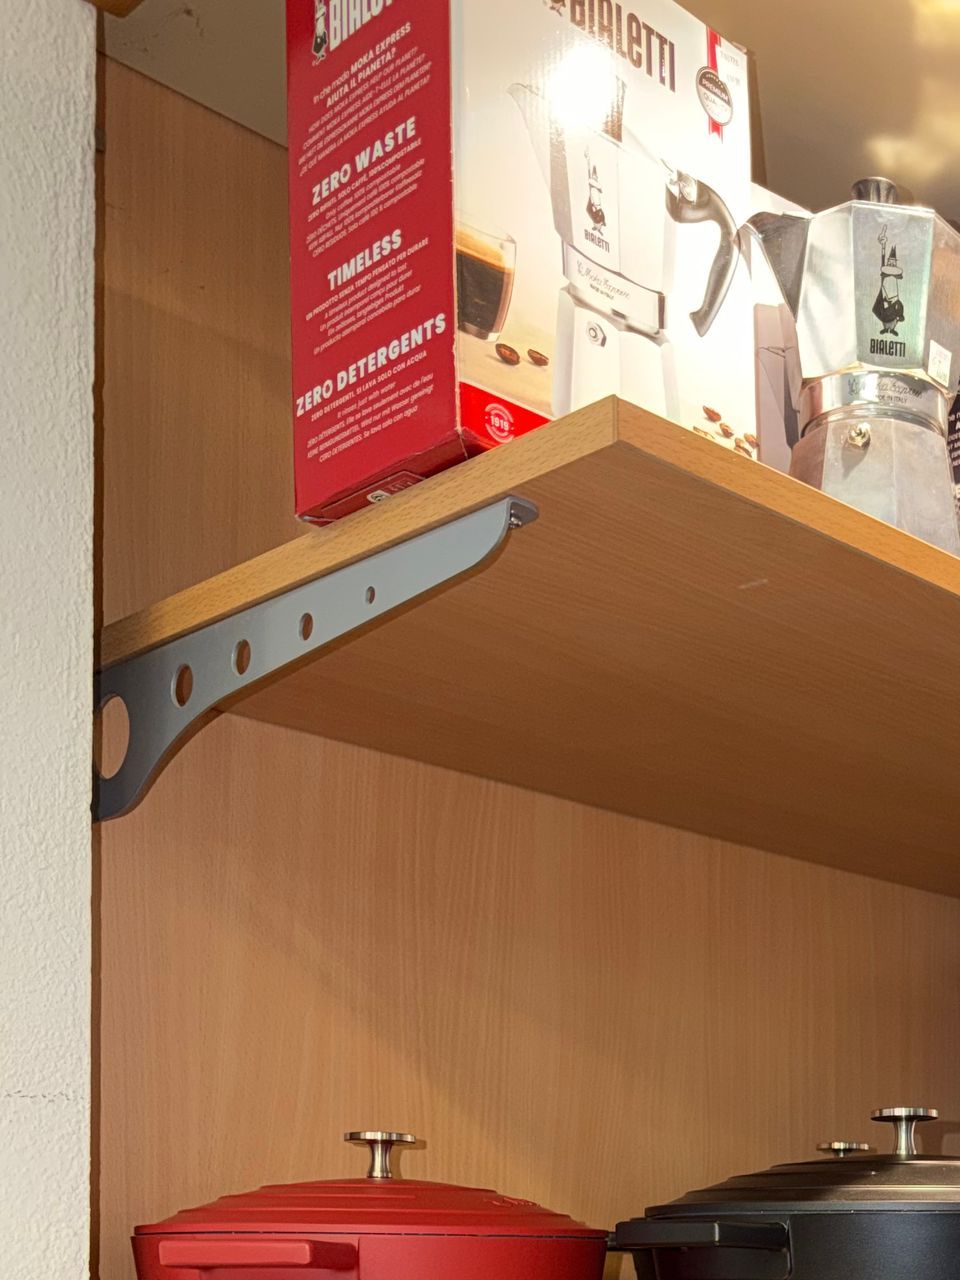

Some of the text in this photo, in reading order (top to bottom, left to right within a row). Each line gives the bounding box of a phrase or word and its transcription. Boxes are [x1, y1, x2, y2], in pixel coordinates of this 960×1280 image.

[313, 21, 410, 105] In che modo MOKA EXPRESS
[326, 47, 395, 107] AIUTA IL PIANETA?
[312, 116, 415, 205] ZERO WASTE
[327, 228, 401, 290] TIMELESS
[296, 312, 445, 416] ZERO DETERGENTS
[311, 409, 322, 421] ZERO
[356, 386, 361, 395] SI
[362, 378, 376, 391] LAVA
[377, 369, 391, 383] SOLO
[393, 361, 405, 374] CON
[406, 349, 426, 367] ACQUA
[490, 415, 509, 431] 1919
